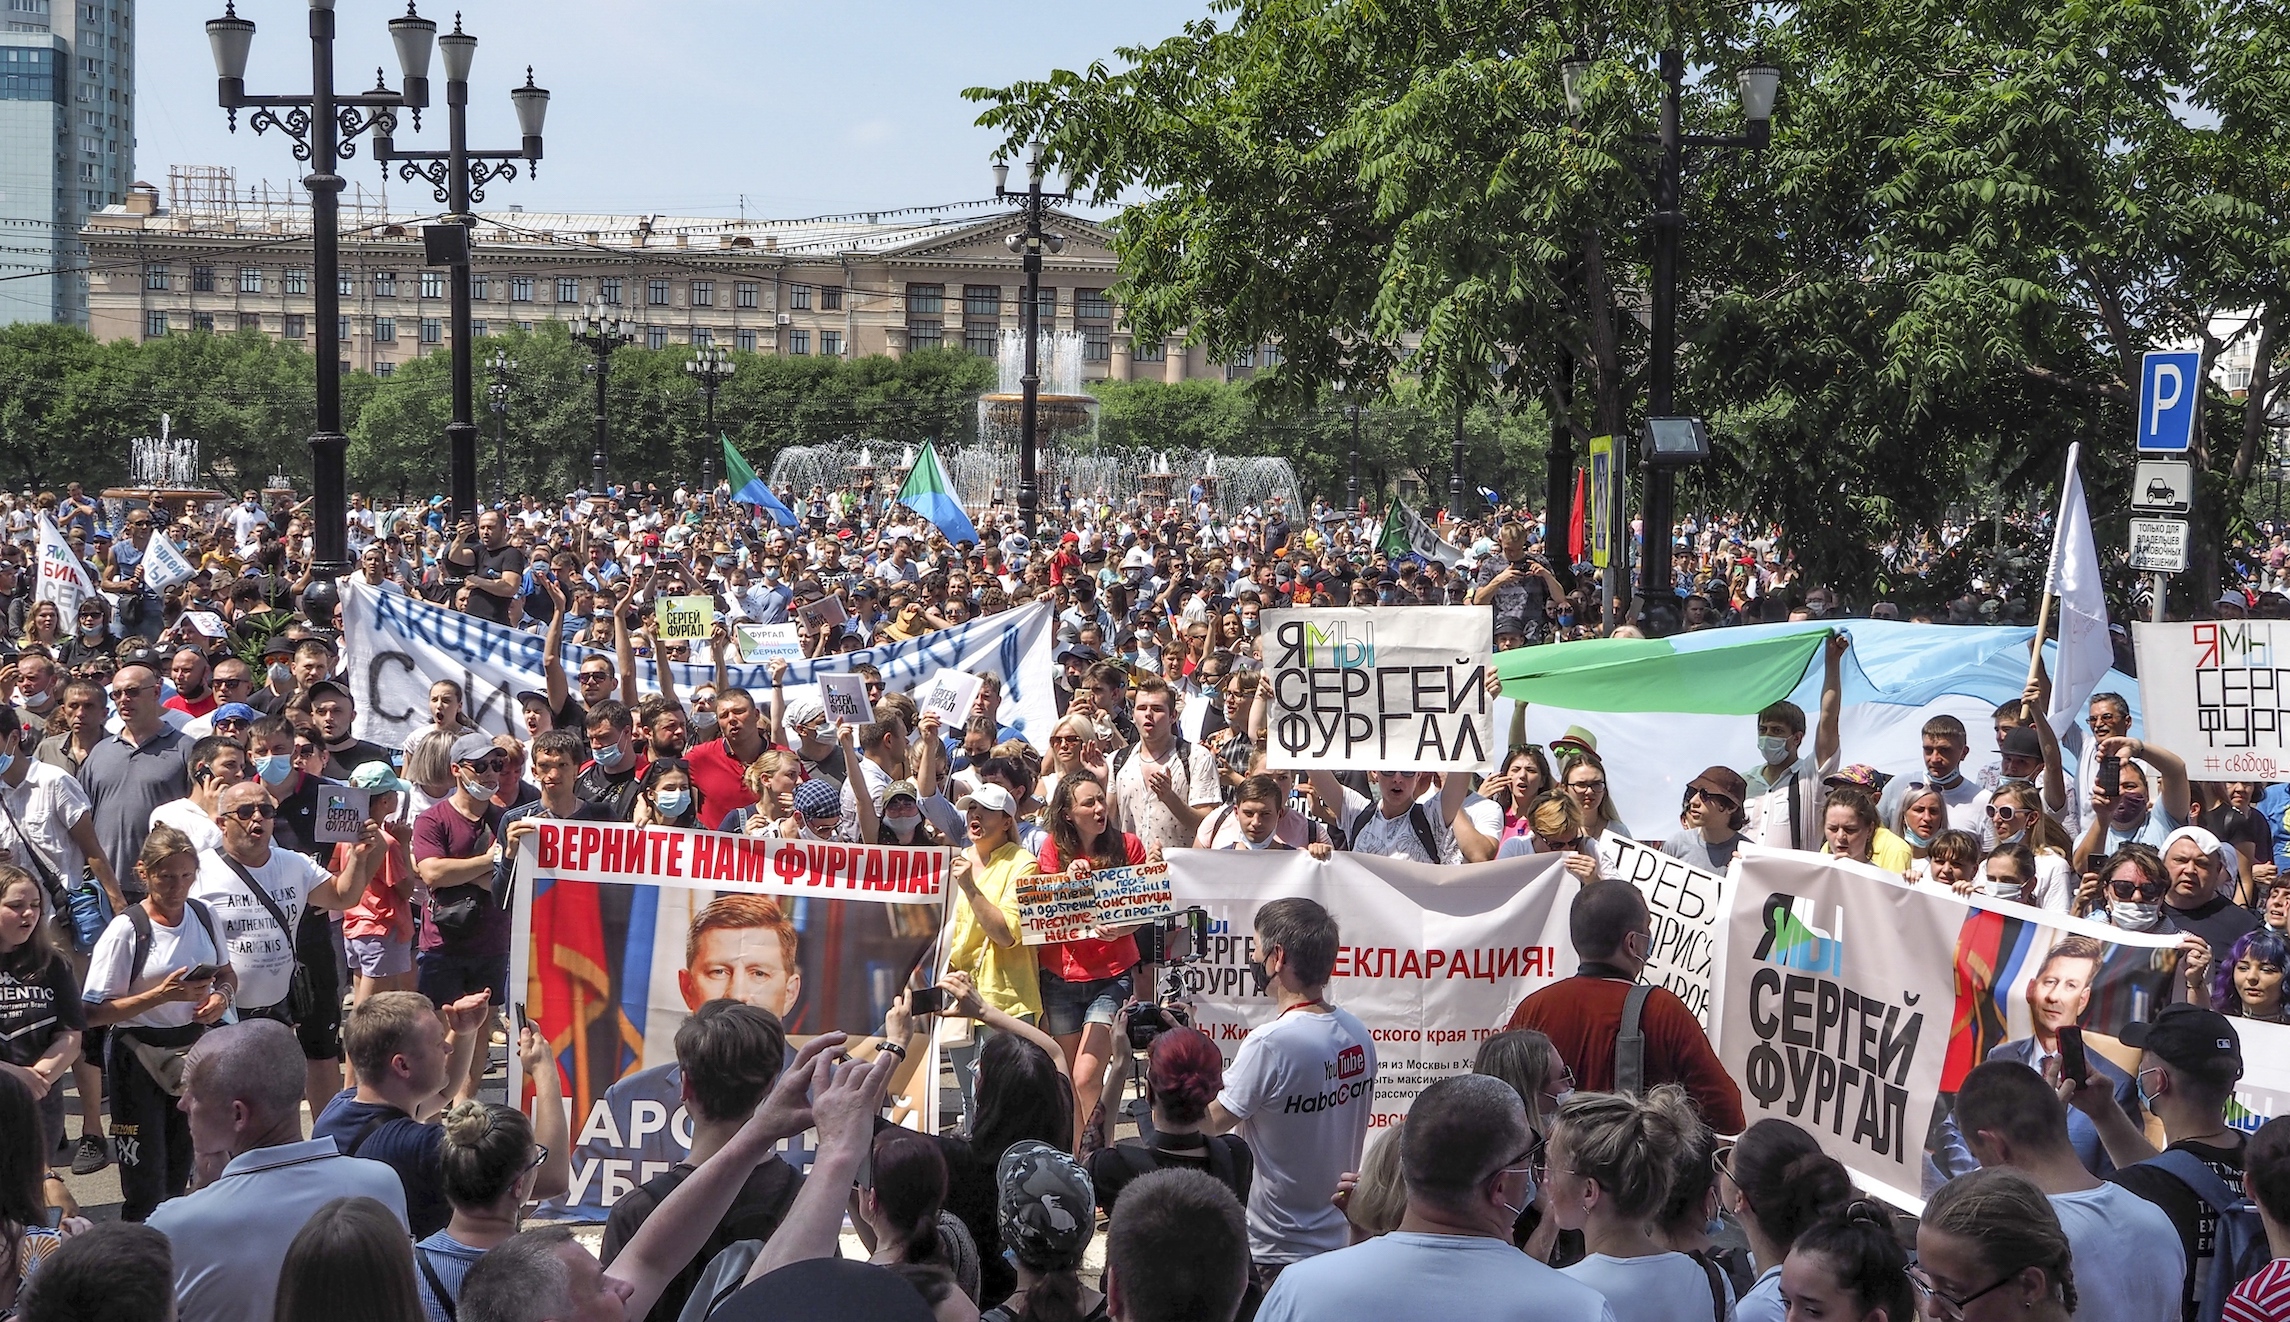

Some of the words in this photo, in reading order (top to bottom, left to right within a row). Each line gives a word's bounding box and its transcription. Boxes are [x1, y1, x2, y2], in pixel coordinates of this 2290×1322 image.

[2138, 523, 2165, 533] ТОЛЬКО
[2165, 524, 2180, 534] ДЛЯ
[2136, 534, 2180, 547] ВЛАДЕЛЬЦЕВ
[2133, 544, 2182, 557] ПАРКОВОЧНЫХ
[2135, 556, 2178, 567] РАЗРЕШЕНИЙ
[43, 561, 83, 587] БИК
[666, 609, 701, 625] СЕРГЕЙ
[667, 623, 704, 637] ФУРГАЛ
[1274, 621, 1375, 669] ЯМЫ
[2193, 622, 2274, 668] ЯМЫ
[1275, 657, 1485, 714] СЕРГЕЙ
[1277, 712, 1486, 762] ФУРГАЛ
[327, 807, 359, 821] СЕРГЕЙ
[325, 820, 362, 833] ФУРГАЛ
[538, 823, 684, 877] ВЕРНИТЕ
[691, 835, 766, 883] НАМ
[774, 843, 943, 895] ФУРГАЛА!
[227, 917, 279, 931] AUTHENTIC
[1752, 892, 1844, 978] ЯМЫ
[1199, 936, 1257, 965] ЕРГЕ
[1332, 946, 1556, 985] ЕКЛАРАЦИЯ!
[31, 1001, 47, 1009] Brand
[1749, 967, 1924, 1087] СЕРГЕЙ
[1427, 1027, 1466, 1046] края
[1391, 1061, 1403, 1070] из
[1406, 1059, 1450, 1070] Москвы
[1453, 1061, 1459, 1069] в
[1374, 1089, 1422, 1101] рассмот
[1746, 1041, 1909, 1165] ФУРГАЛ
